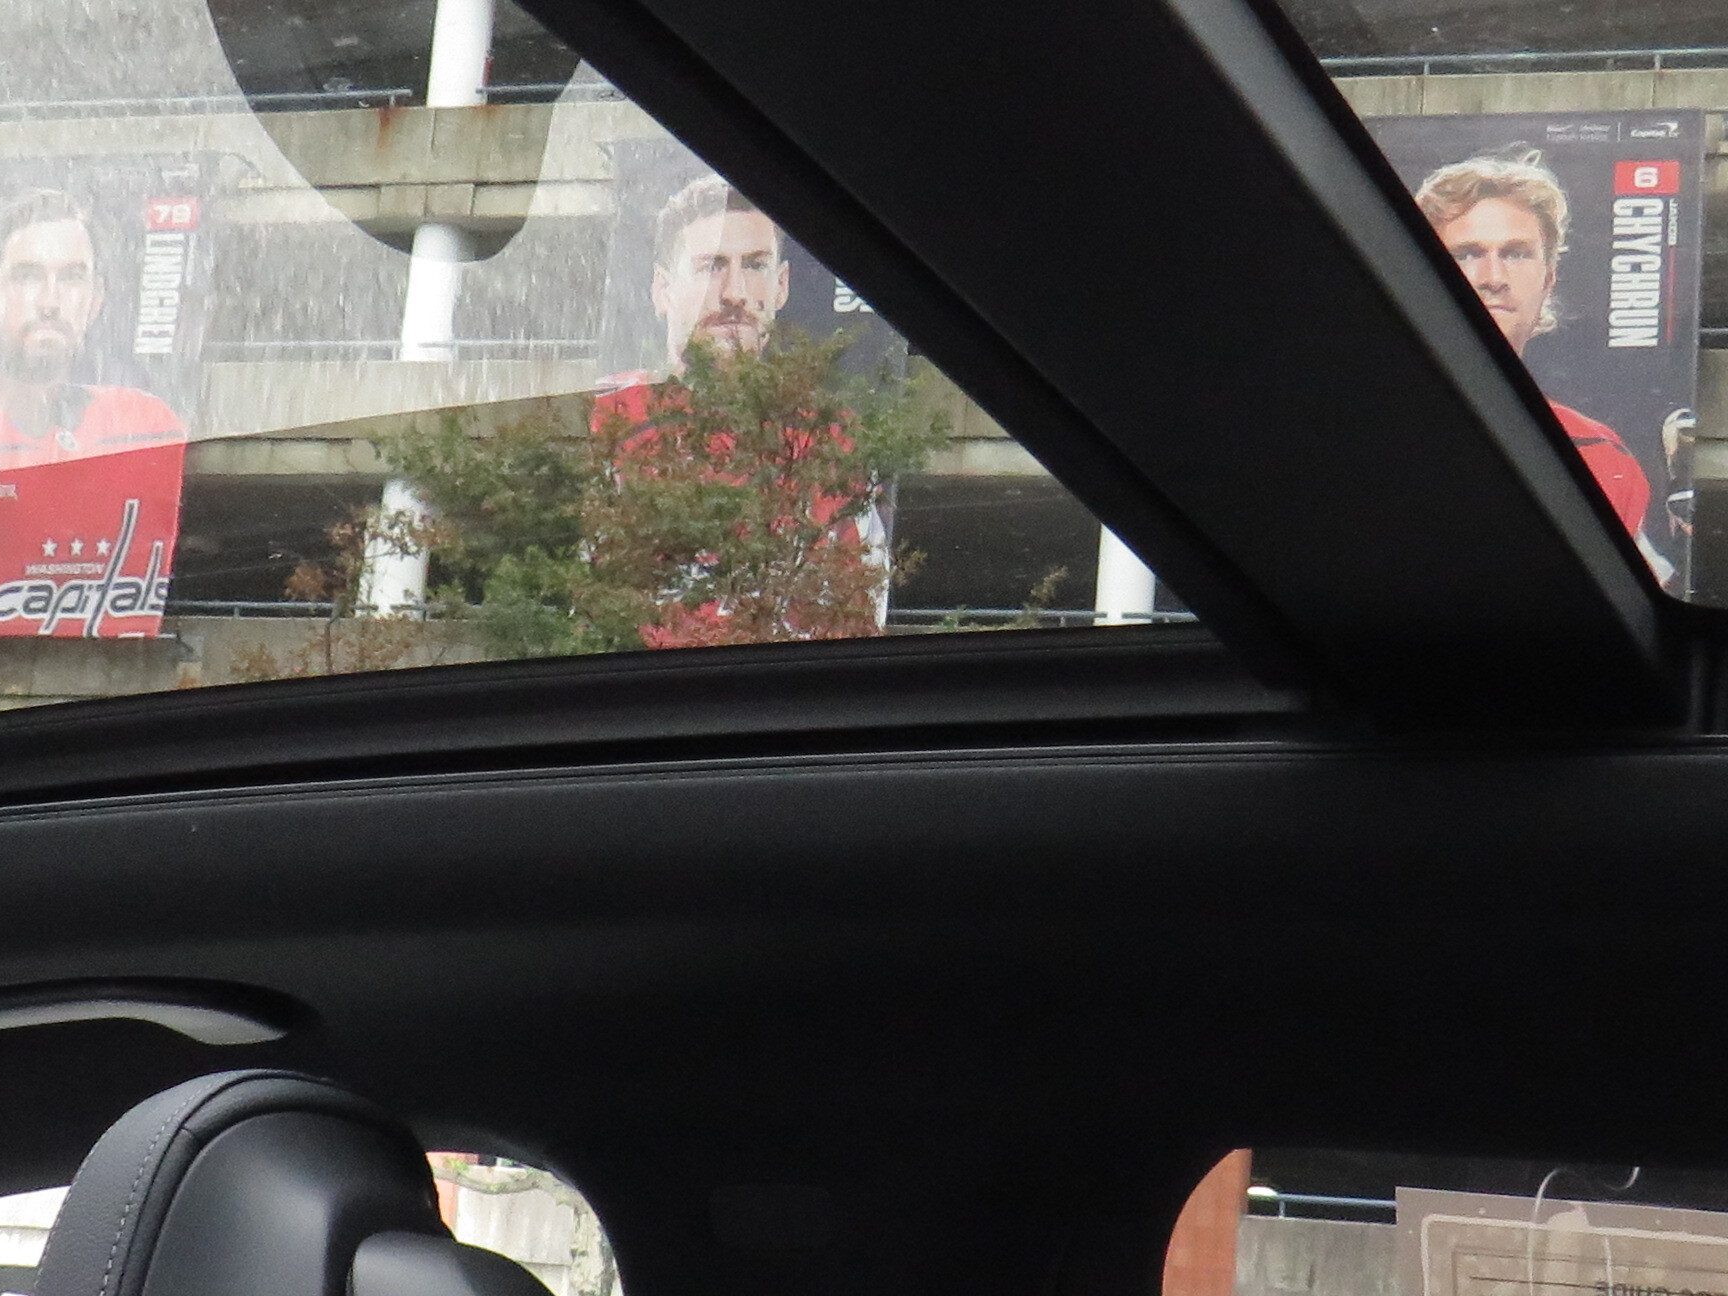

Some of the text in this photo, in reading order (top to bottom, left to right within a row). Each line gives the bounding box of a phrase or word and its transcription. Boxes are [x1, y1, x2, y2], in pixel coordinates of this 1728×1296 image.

[1633, 165, 1659, 189] 6
[133, 232, 186, 355] LINDGREN
[1607, 197, 1664, 348] CHYCHRUN
